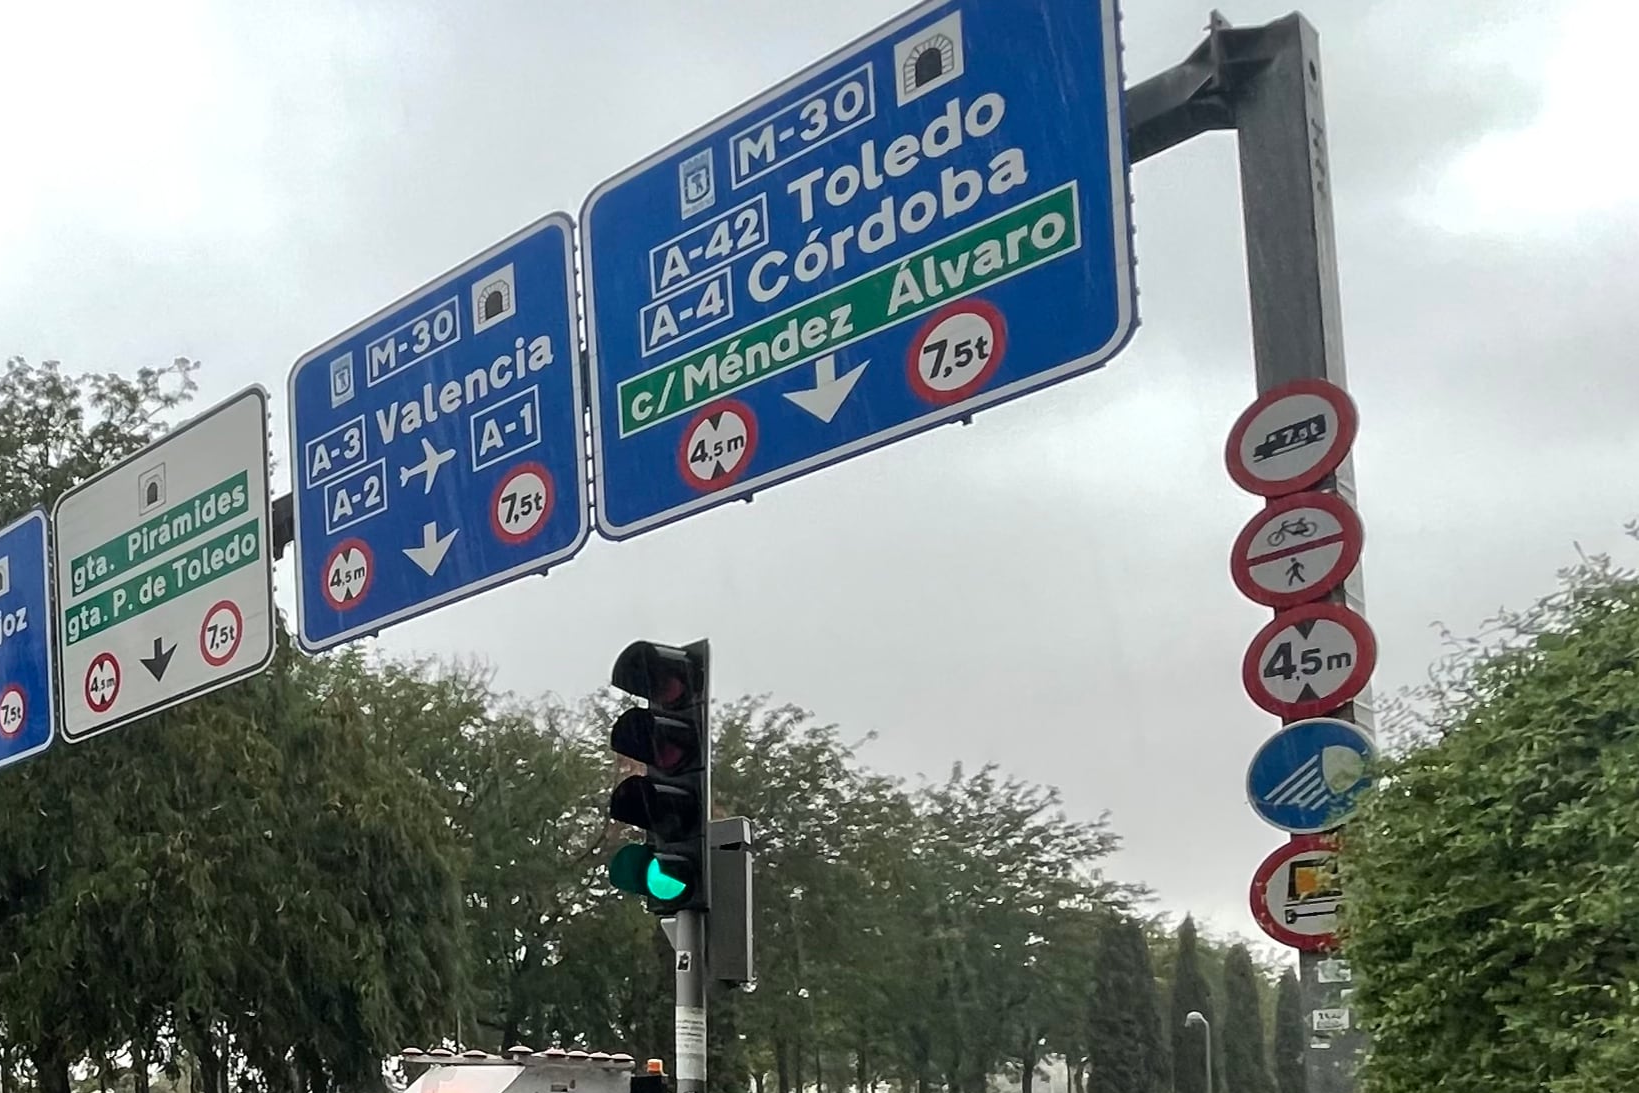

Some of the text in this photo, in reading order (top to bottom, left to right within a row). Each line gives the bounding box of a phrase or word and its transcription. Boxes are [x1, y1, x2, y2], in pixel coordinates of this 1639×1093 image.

[735, 80, 866, 178] M-30
[658, 92, 1006, 288] A-42 Toledo
[648, 148, 1029, 348] A-4 Córdoba
[885, 211, 1066, 317] Álvaro
[370, 308, 454, 378] M-30
[375, 335, 554, 445] Valencia
[310, 428, 361, 478] A-3
[478, 402, 533, 457] A-1
[73, 481, 246, 592] gta. Pirámides
[331, 475, 382, 523] A-2
[67, 529, 257, 643] gta. P. de Toledo
